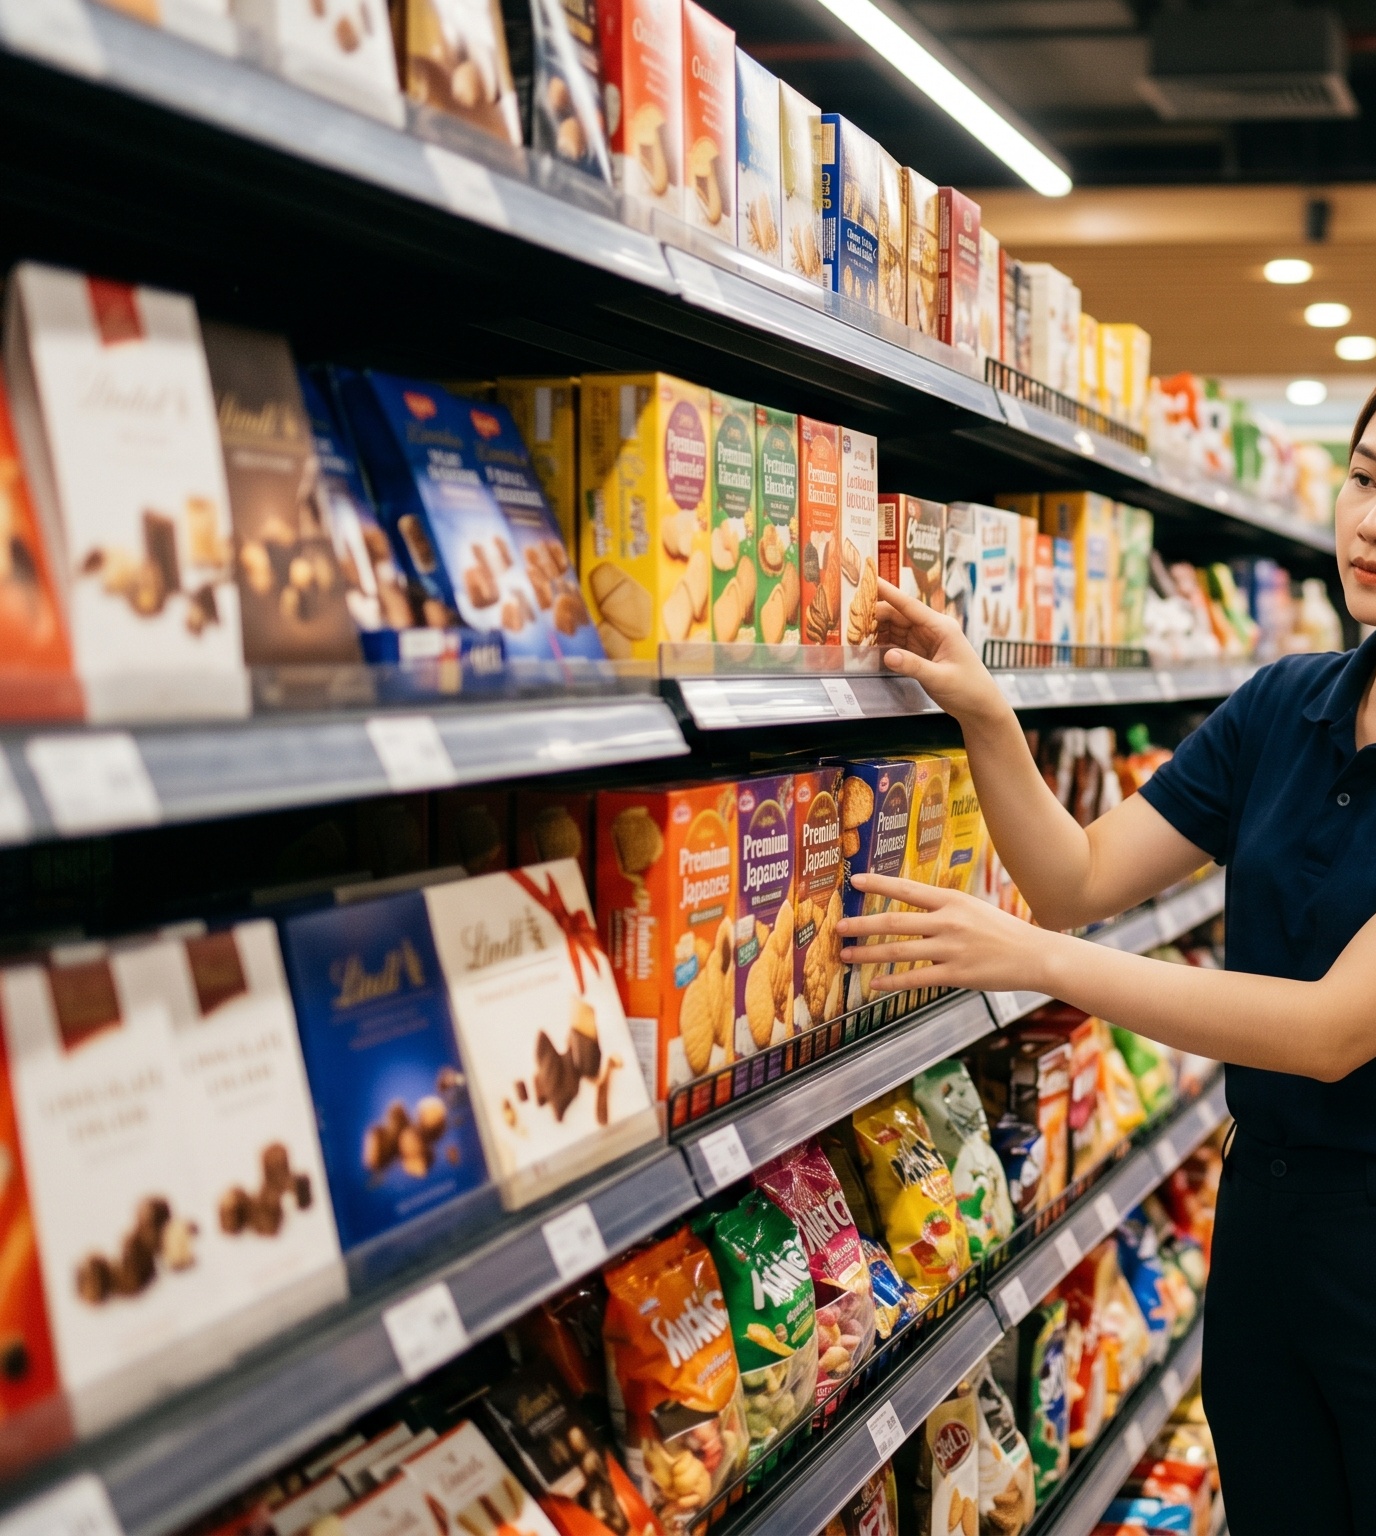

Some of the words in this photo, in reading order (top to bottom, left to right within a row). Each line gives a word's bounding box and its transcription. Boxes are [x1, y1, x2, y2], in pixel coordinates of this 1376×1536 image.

[678, 842, 730, 876] Premium
[742, 829, 789, 860] Premium
[678, 874, 730, 909] Japanese
[742, 859, 789, 892] Japanese
